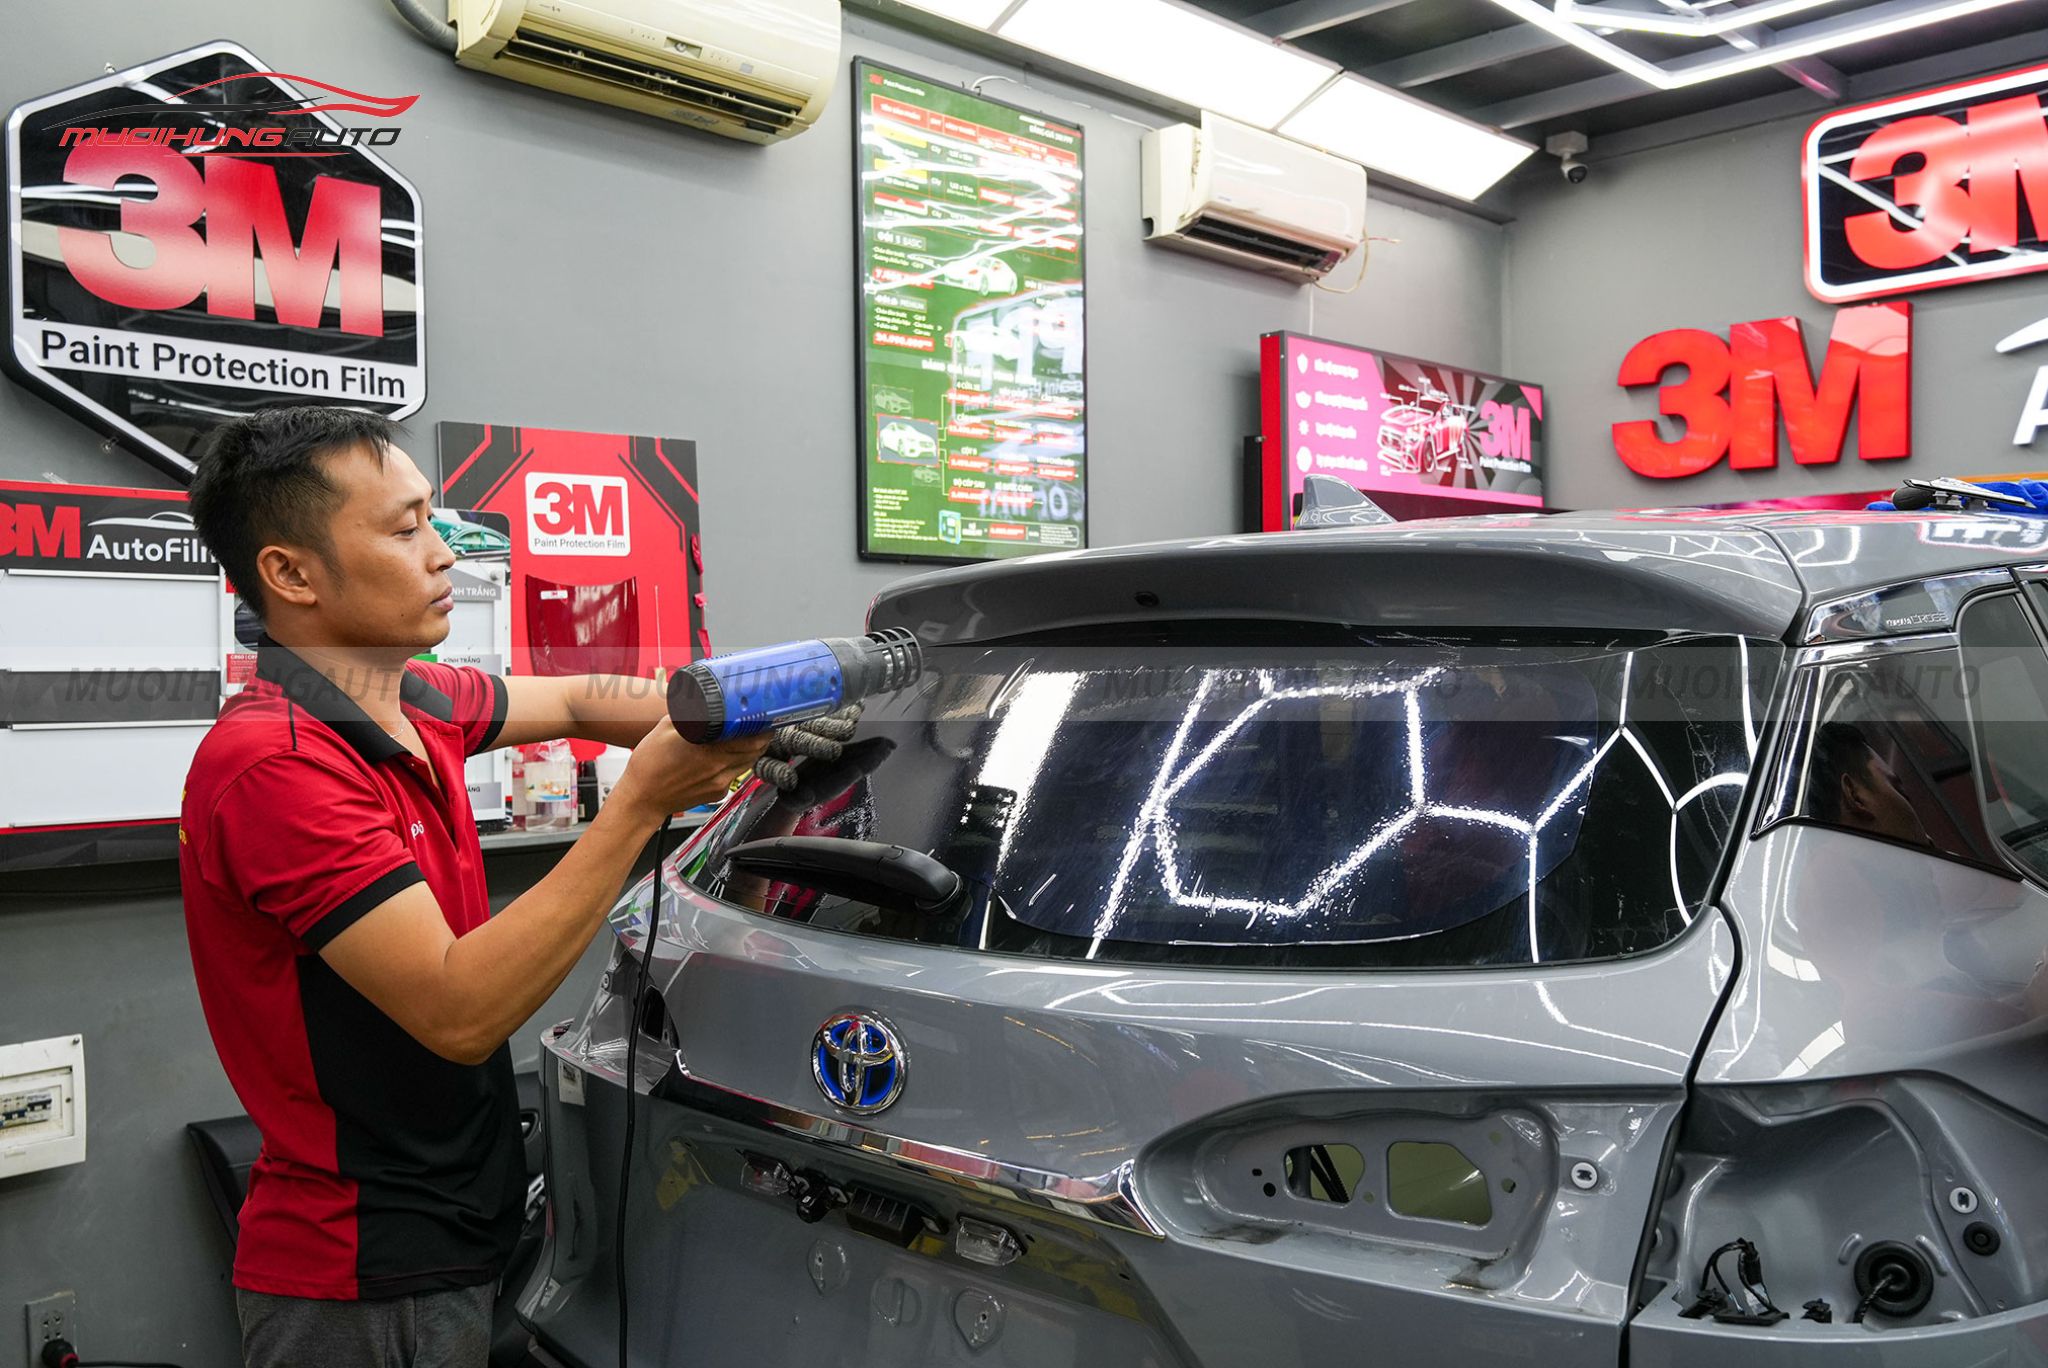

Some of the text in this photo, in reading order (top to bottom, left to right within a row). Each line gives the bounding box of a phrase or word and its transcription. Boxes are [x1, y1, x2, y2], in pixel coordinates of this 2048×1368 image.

[57, 132, 384, 338] 3M
[40, 329, 406, 399] Paint Protection Film
[1611, 302, 1913, 479] 3M
[1479, 399, 1532, 461] 3M
[533, 481, 625, 536] 3M
[534, 538, 626, 549] Paint Protection Film
